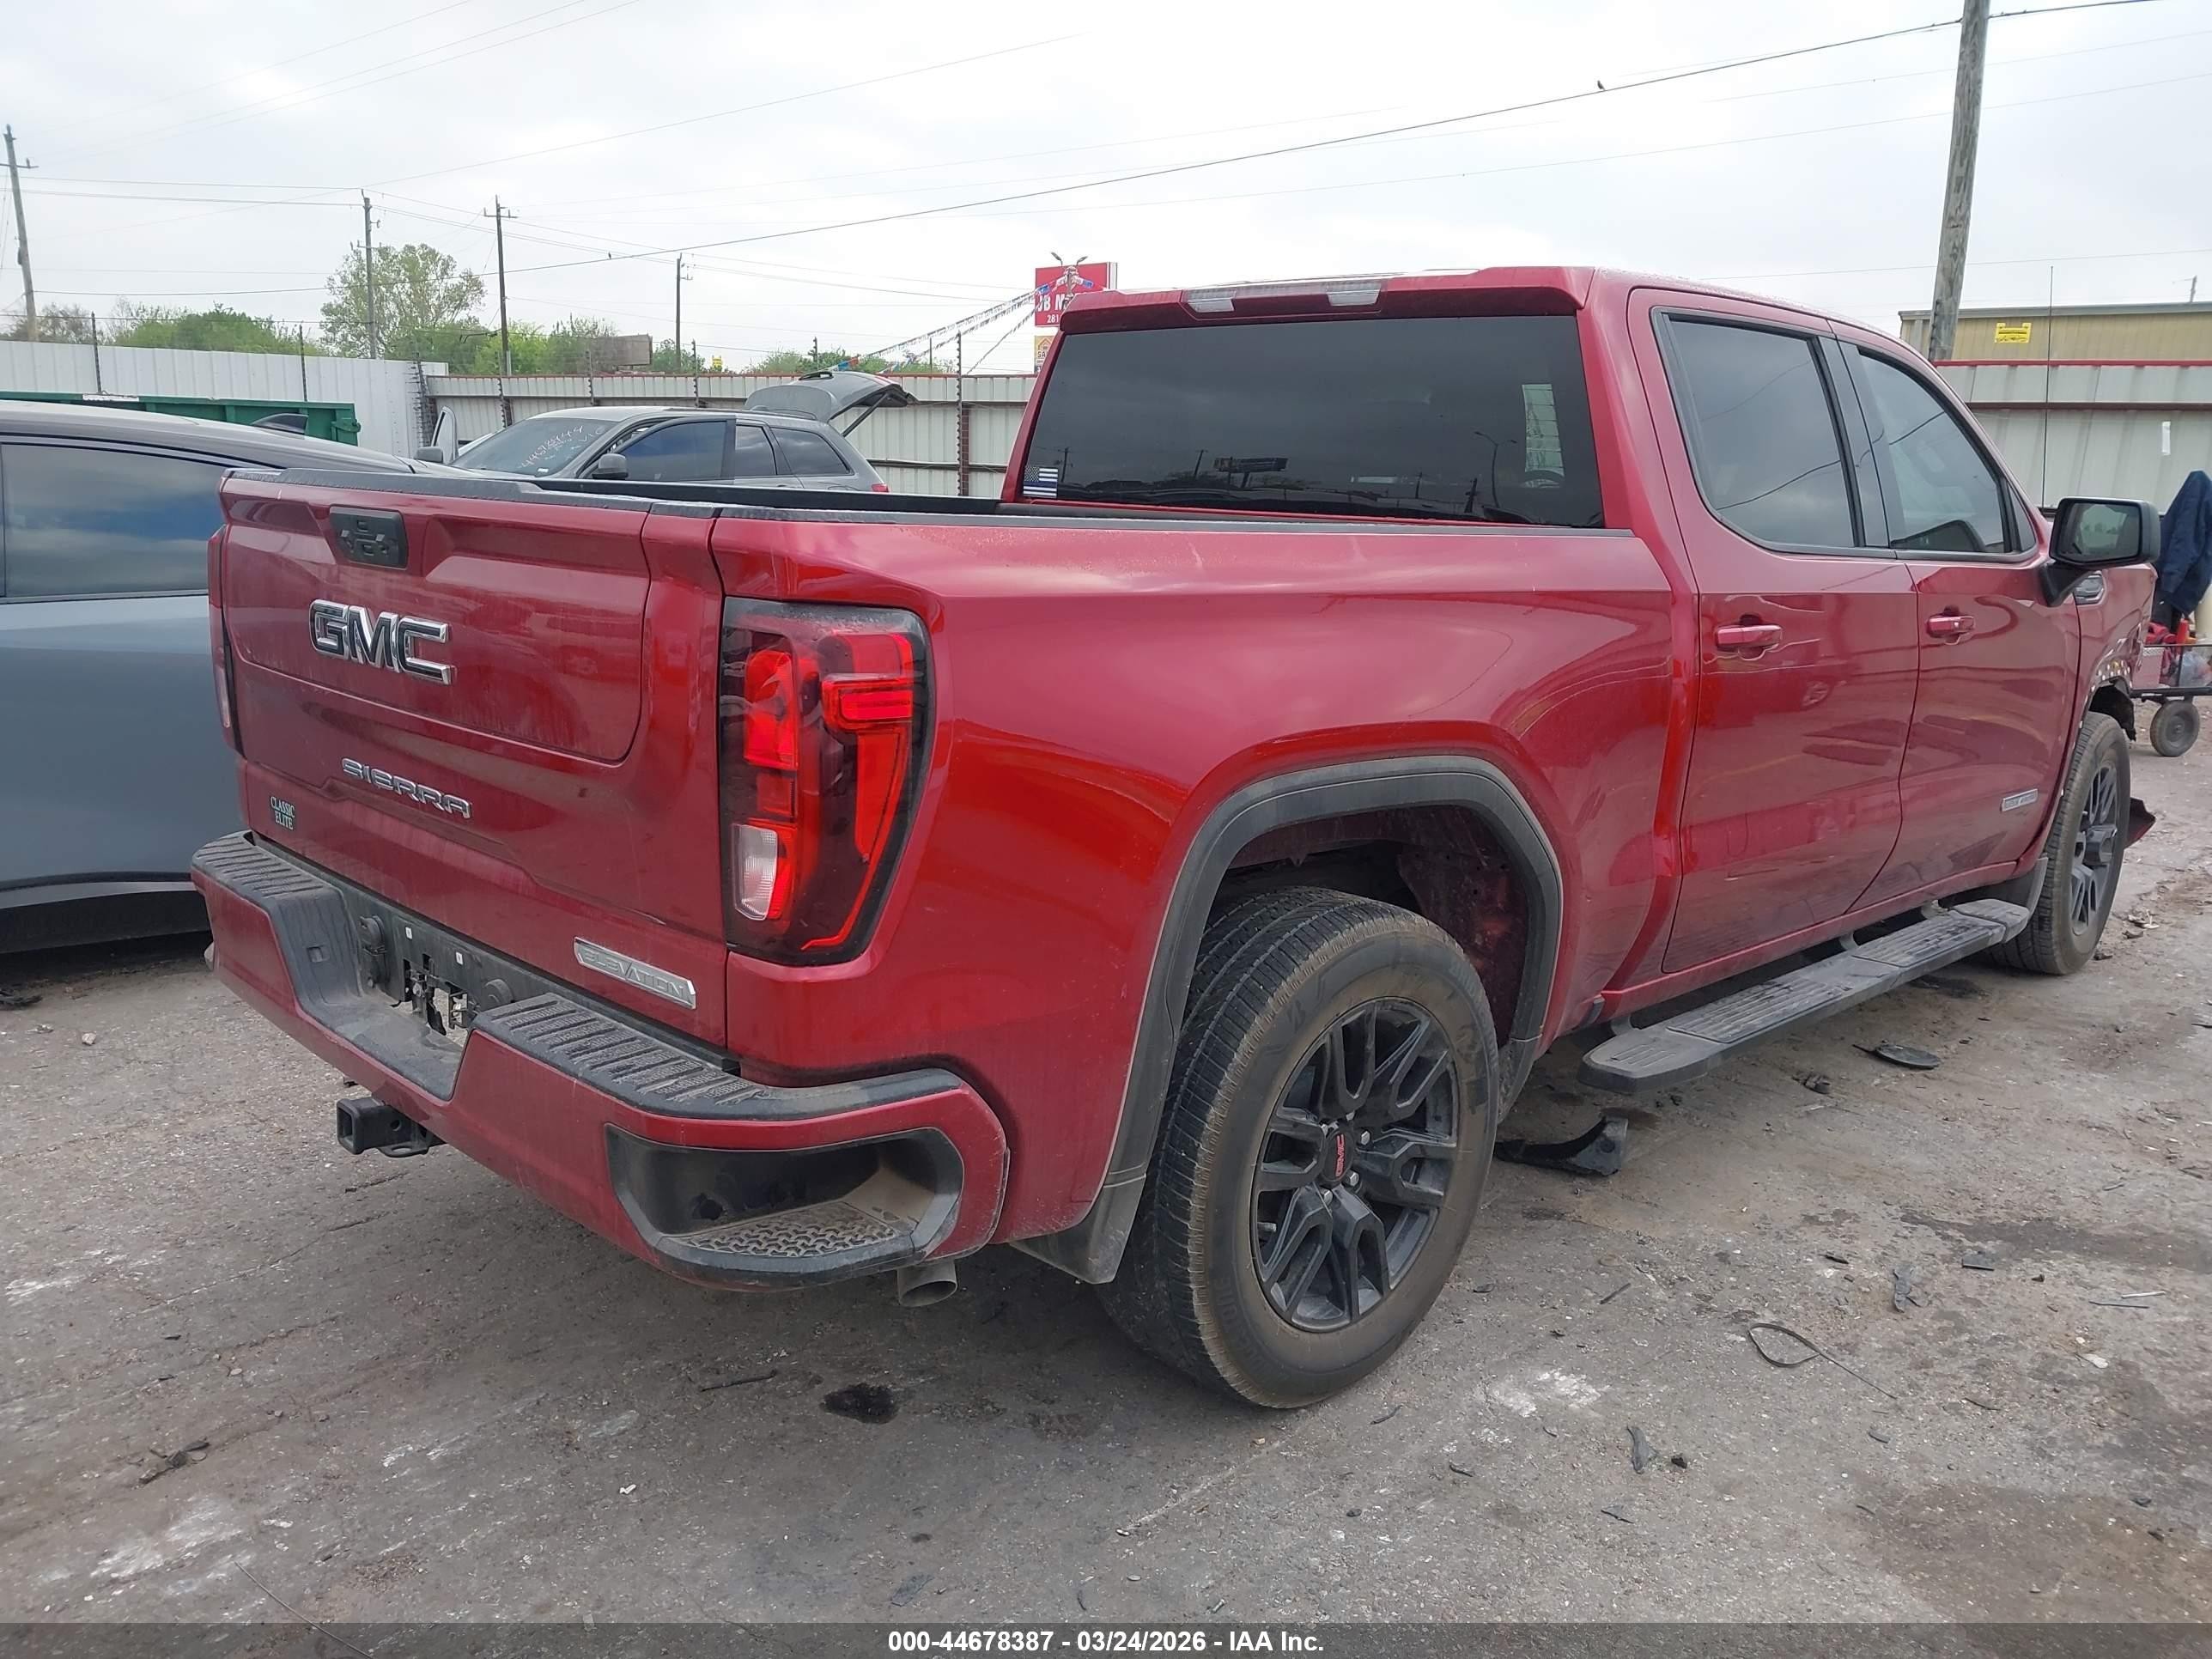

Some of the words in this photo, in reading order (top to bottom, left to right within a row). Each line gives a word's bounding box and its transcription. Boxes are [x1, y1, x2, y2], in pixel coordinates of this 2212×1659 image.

[309, 599, 452, 685] GMC
[270, 796, 295, 817] CLASSIC
[342, 757, 471, 818] SIERRA
[275, 810, 294, 830] ELITE
[582, 946, 688, 1000] ELEVATION
[1335, 1133, 1345, 1176] GMC
